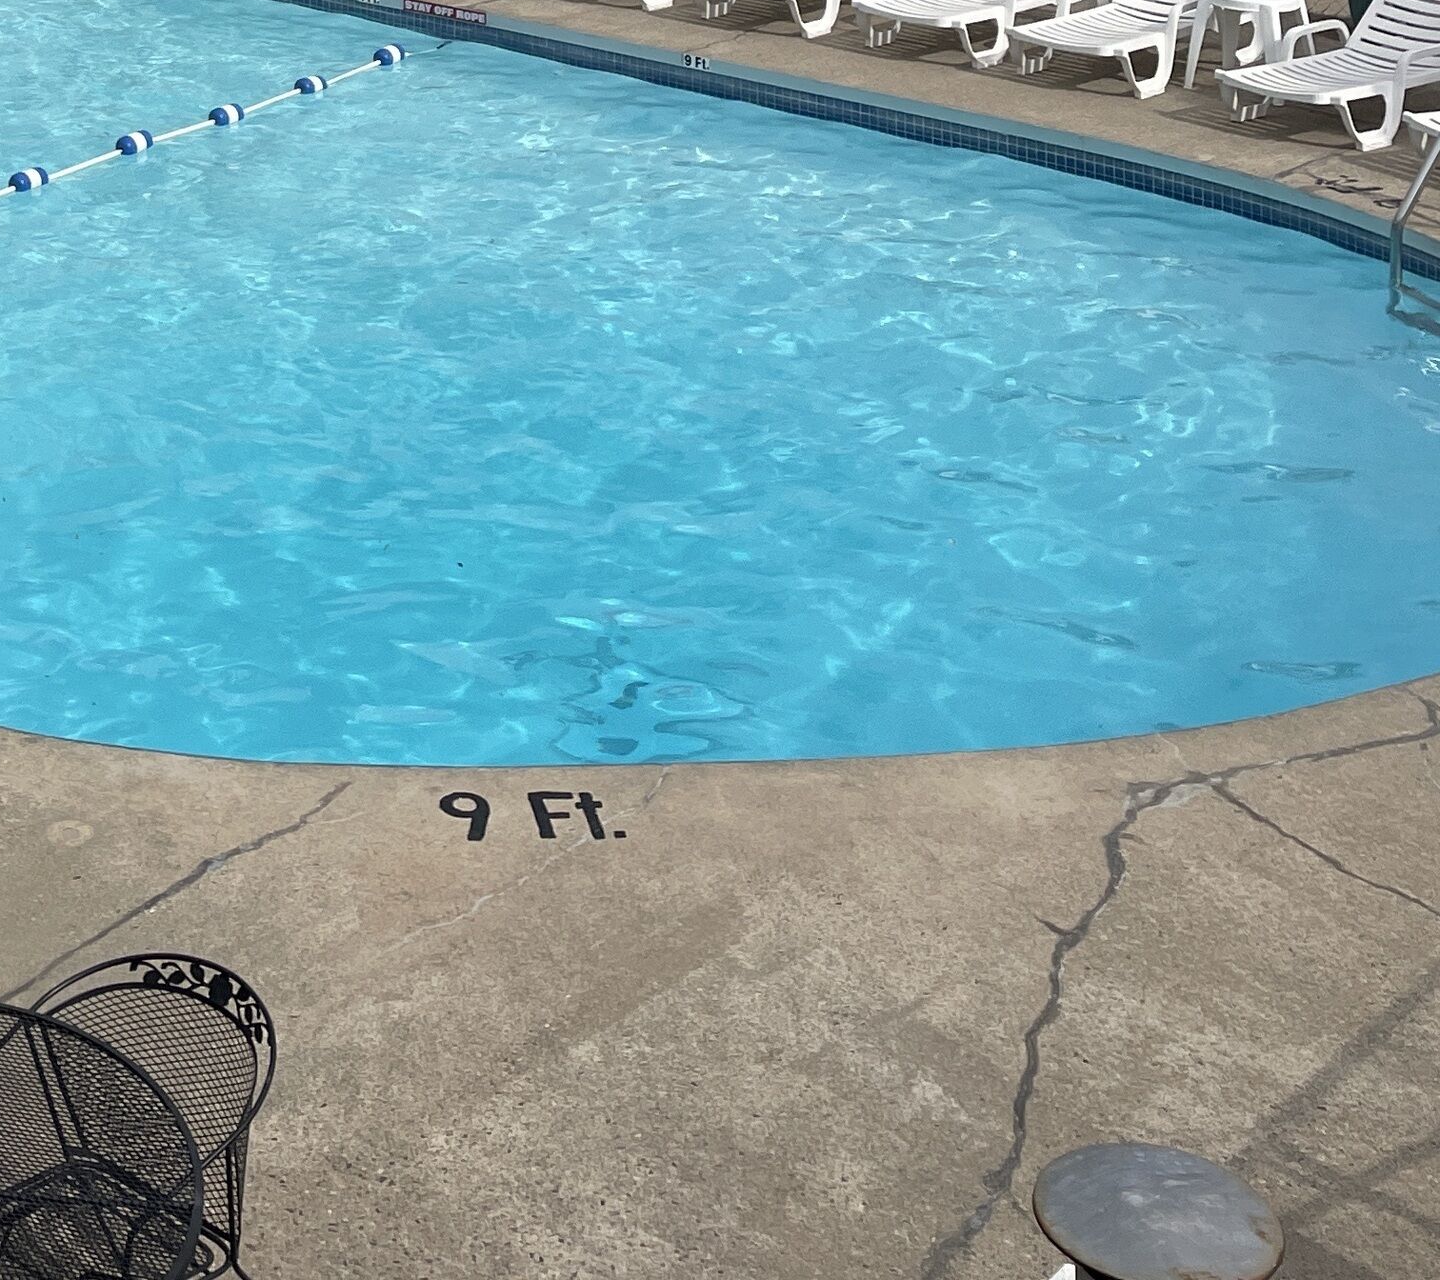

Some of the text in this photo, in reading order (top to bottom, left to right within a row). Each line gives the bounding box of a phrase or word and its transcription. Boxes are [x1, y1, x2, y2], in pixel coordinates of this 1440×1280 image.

[405, 0, 486, 24] STAY OFF ROPE
[684, 54, 710, 70] 9 Ft.
[439, 790, 627, 842] 9 Ft.
